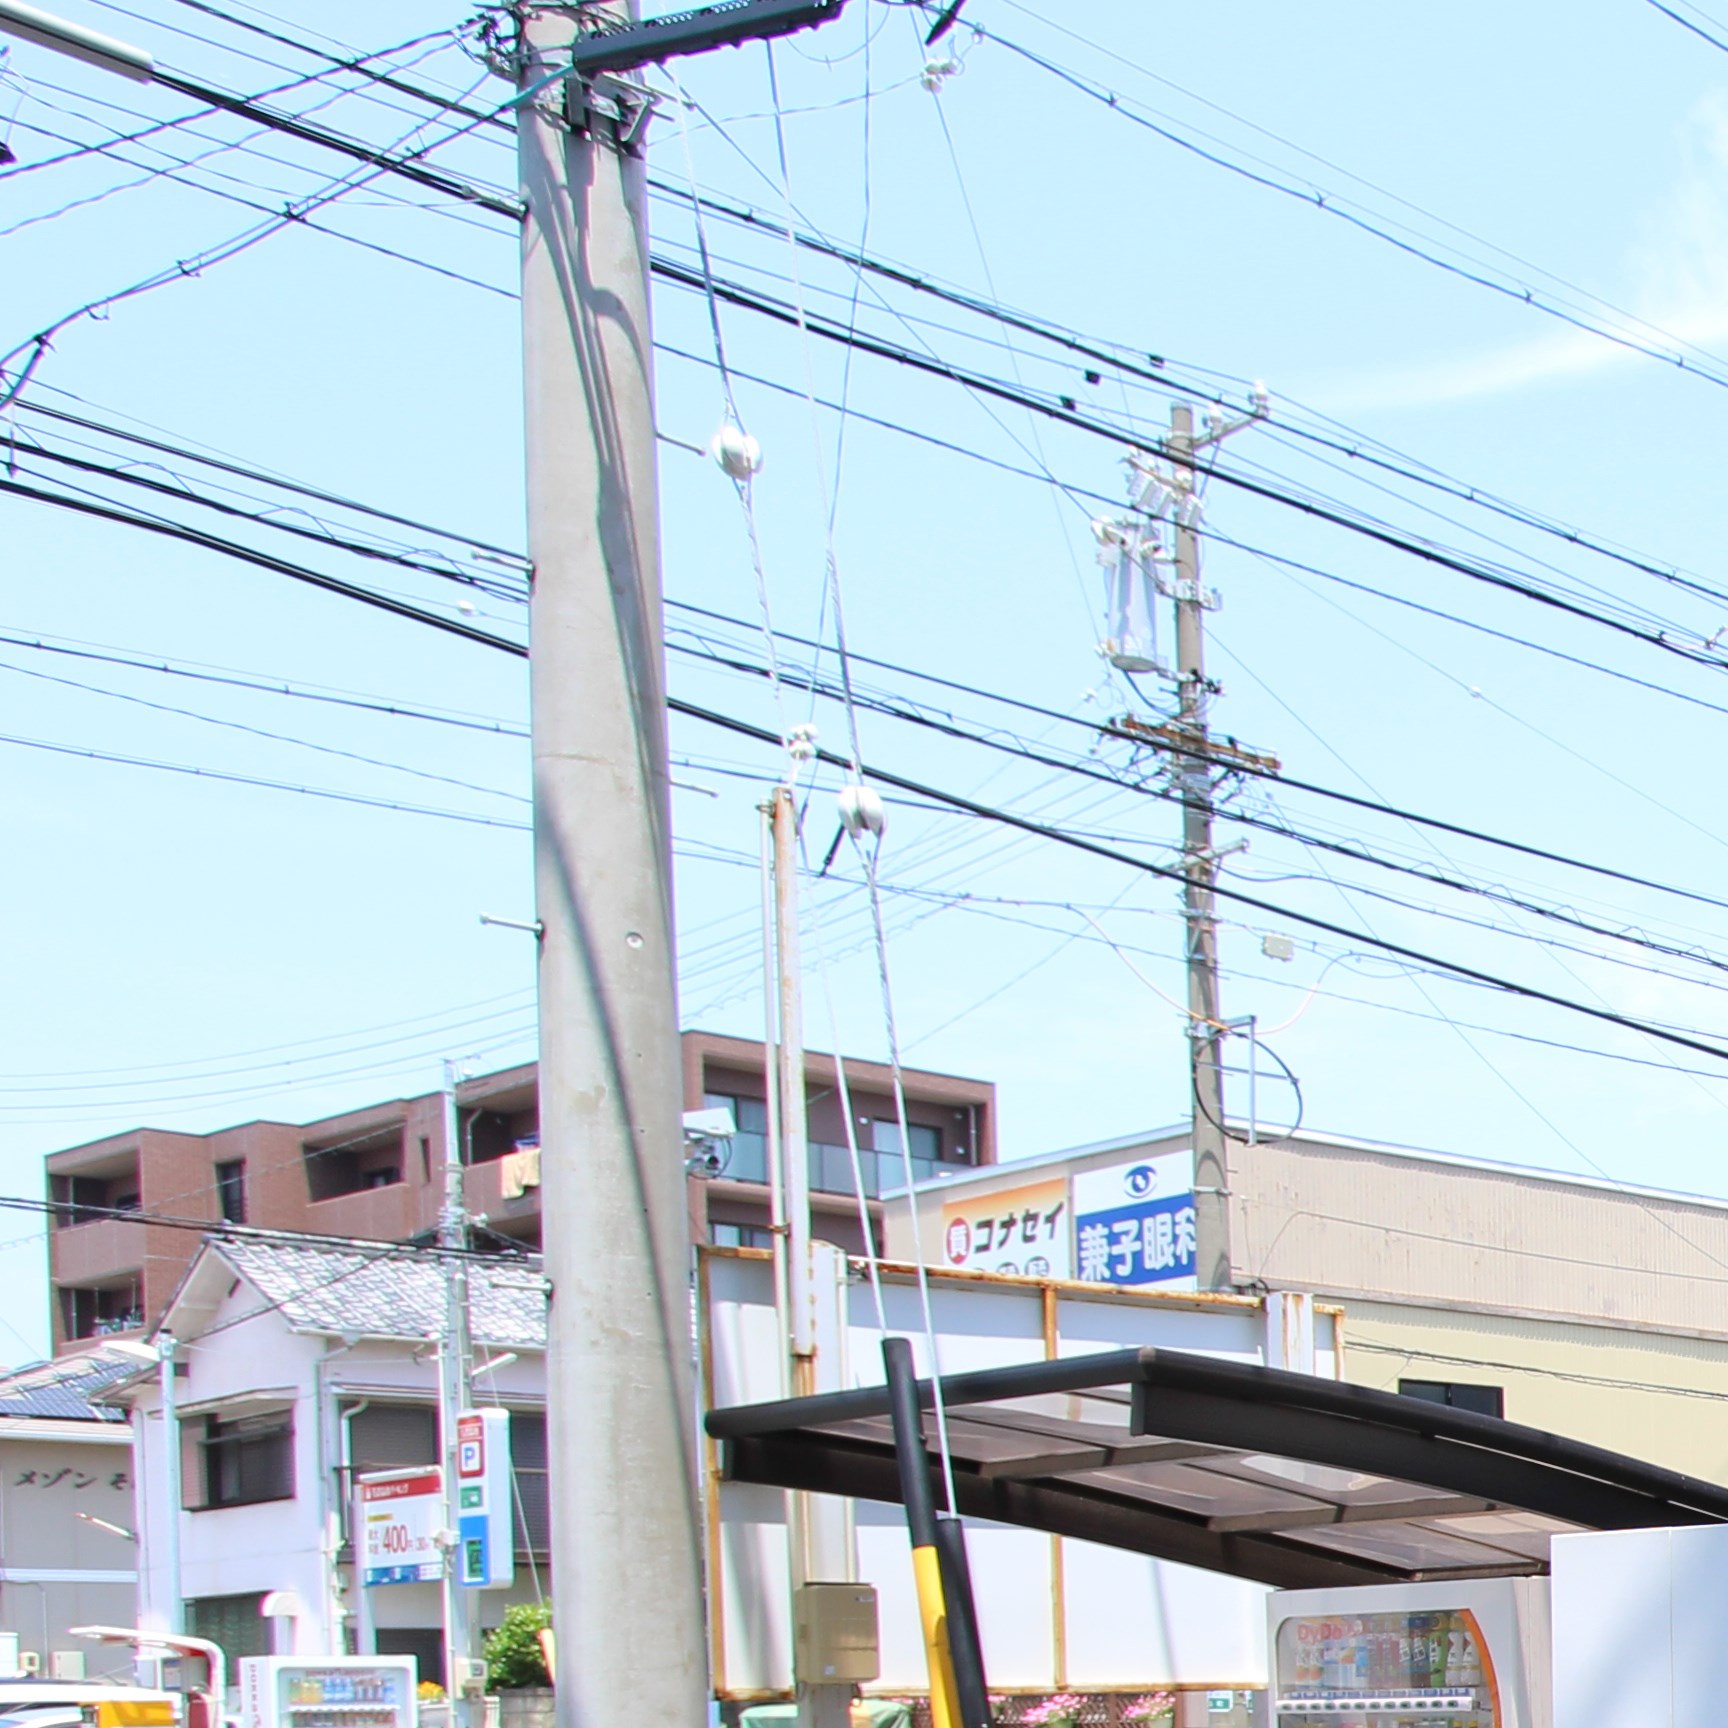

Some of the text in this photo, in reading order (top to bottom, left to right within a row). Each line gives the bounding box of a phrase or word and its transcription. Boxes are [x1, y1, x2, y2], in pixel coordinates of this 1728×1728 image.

[974, 1201, 1065, 1254] コナセイ
[1079, 1206, 1196, 1281] 兼子眼科
[464, 1446, 476, 1467] P
[15, 1468, 98, 1489] メゾン
